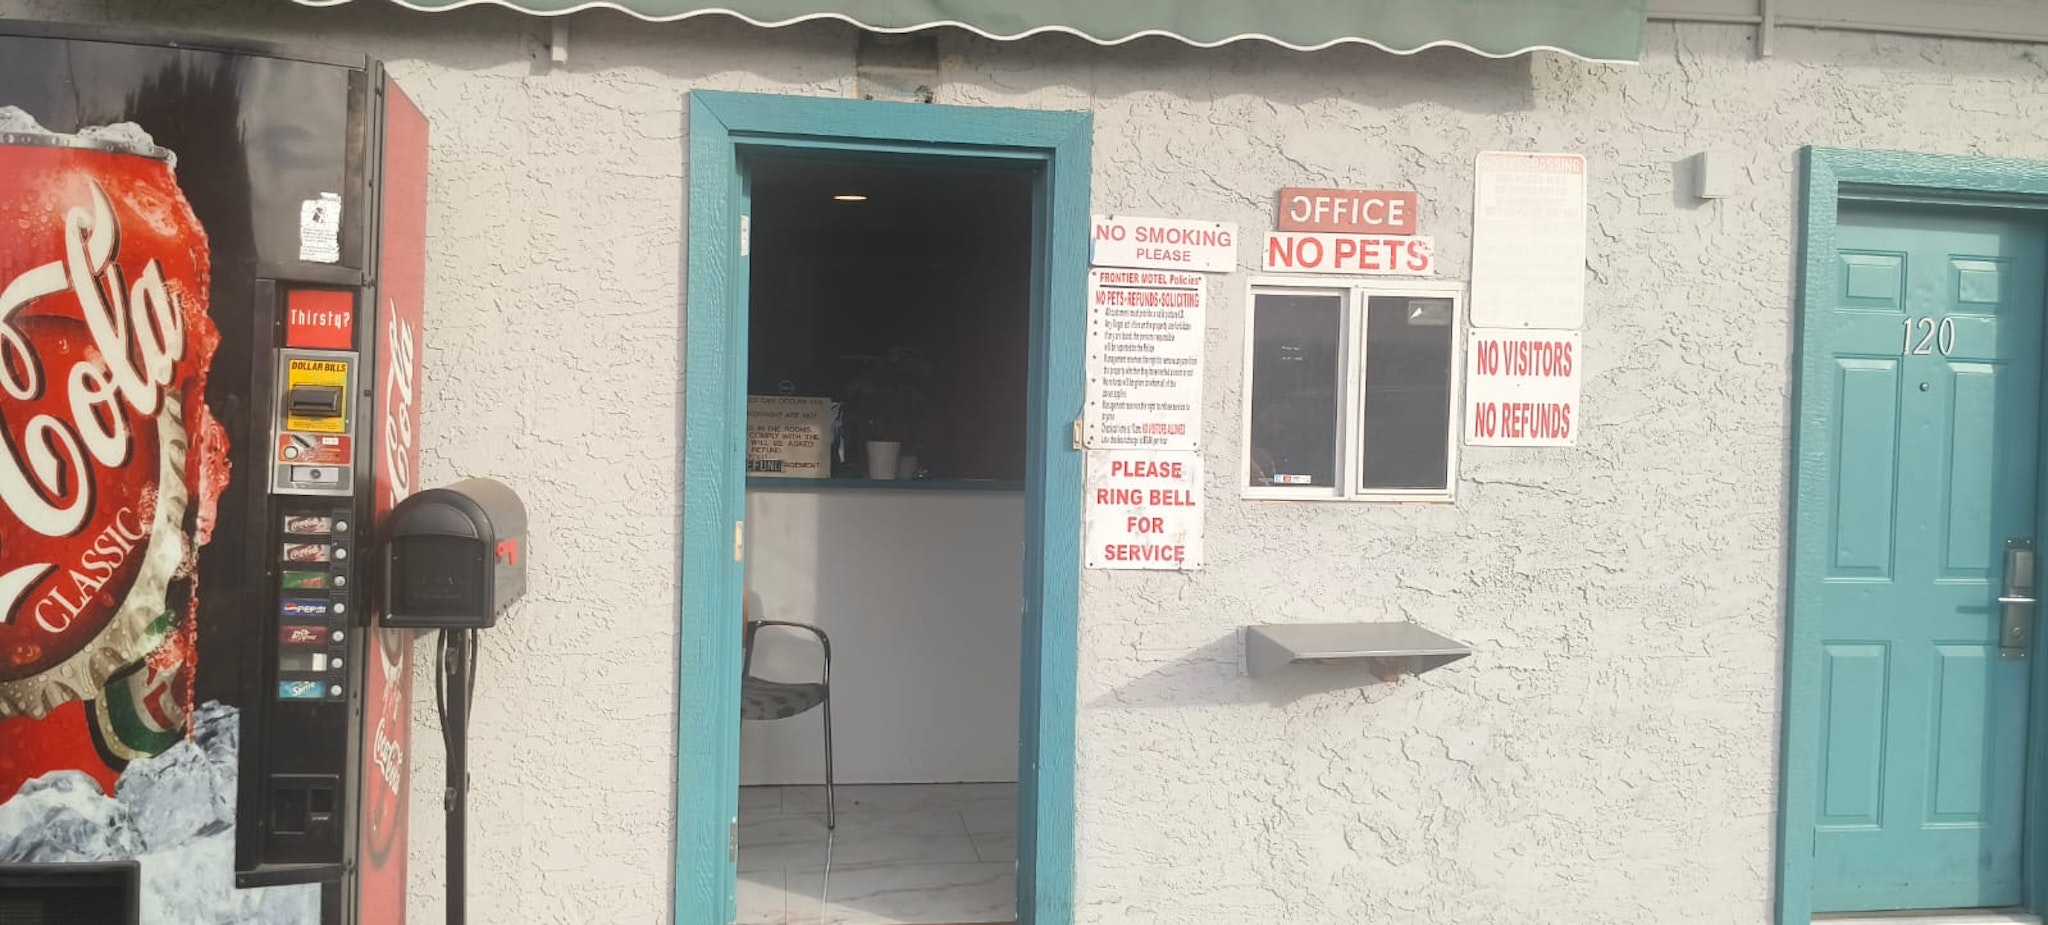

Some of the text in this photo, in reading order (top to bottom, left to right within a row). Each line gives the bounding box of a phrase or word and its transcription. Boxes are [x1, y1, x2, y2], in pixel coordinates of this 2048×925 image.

[1290, 195, 1405, 226] OFFICE
[1096, 224, 1231, 247] NO SMOKING
[1136, 248, 1191, 262] PLEASE
[1269, 237, 1428, 271] NO PETS
[1100, 272, 1139, 283] FRONTIER
[1142, 273, 1167, 284] MOTEL
[1096, 290, 1105, 305] NO
[290, 309, 350, 329] Thirsty?
[1903, 316, 1955, 356] 120
[291, 361, 346, 373] DOLLAR BILLS
[1477, 340, 1572, 377] NO VISITORS
[1475, 402, 1571, 439] NO REFUNDS
[1111, 460, 1183, 478] PLEASE
[1097, 488, 1196, 506] RING BELL
[1127, 516, 1165, 533] FOR
[1104, 544, 1186, 562] SERVICE
[34, 506, 146, 634] CLASSIC
[296, 605, 327, 614] PEPSI
